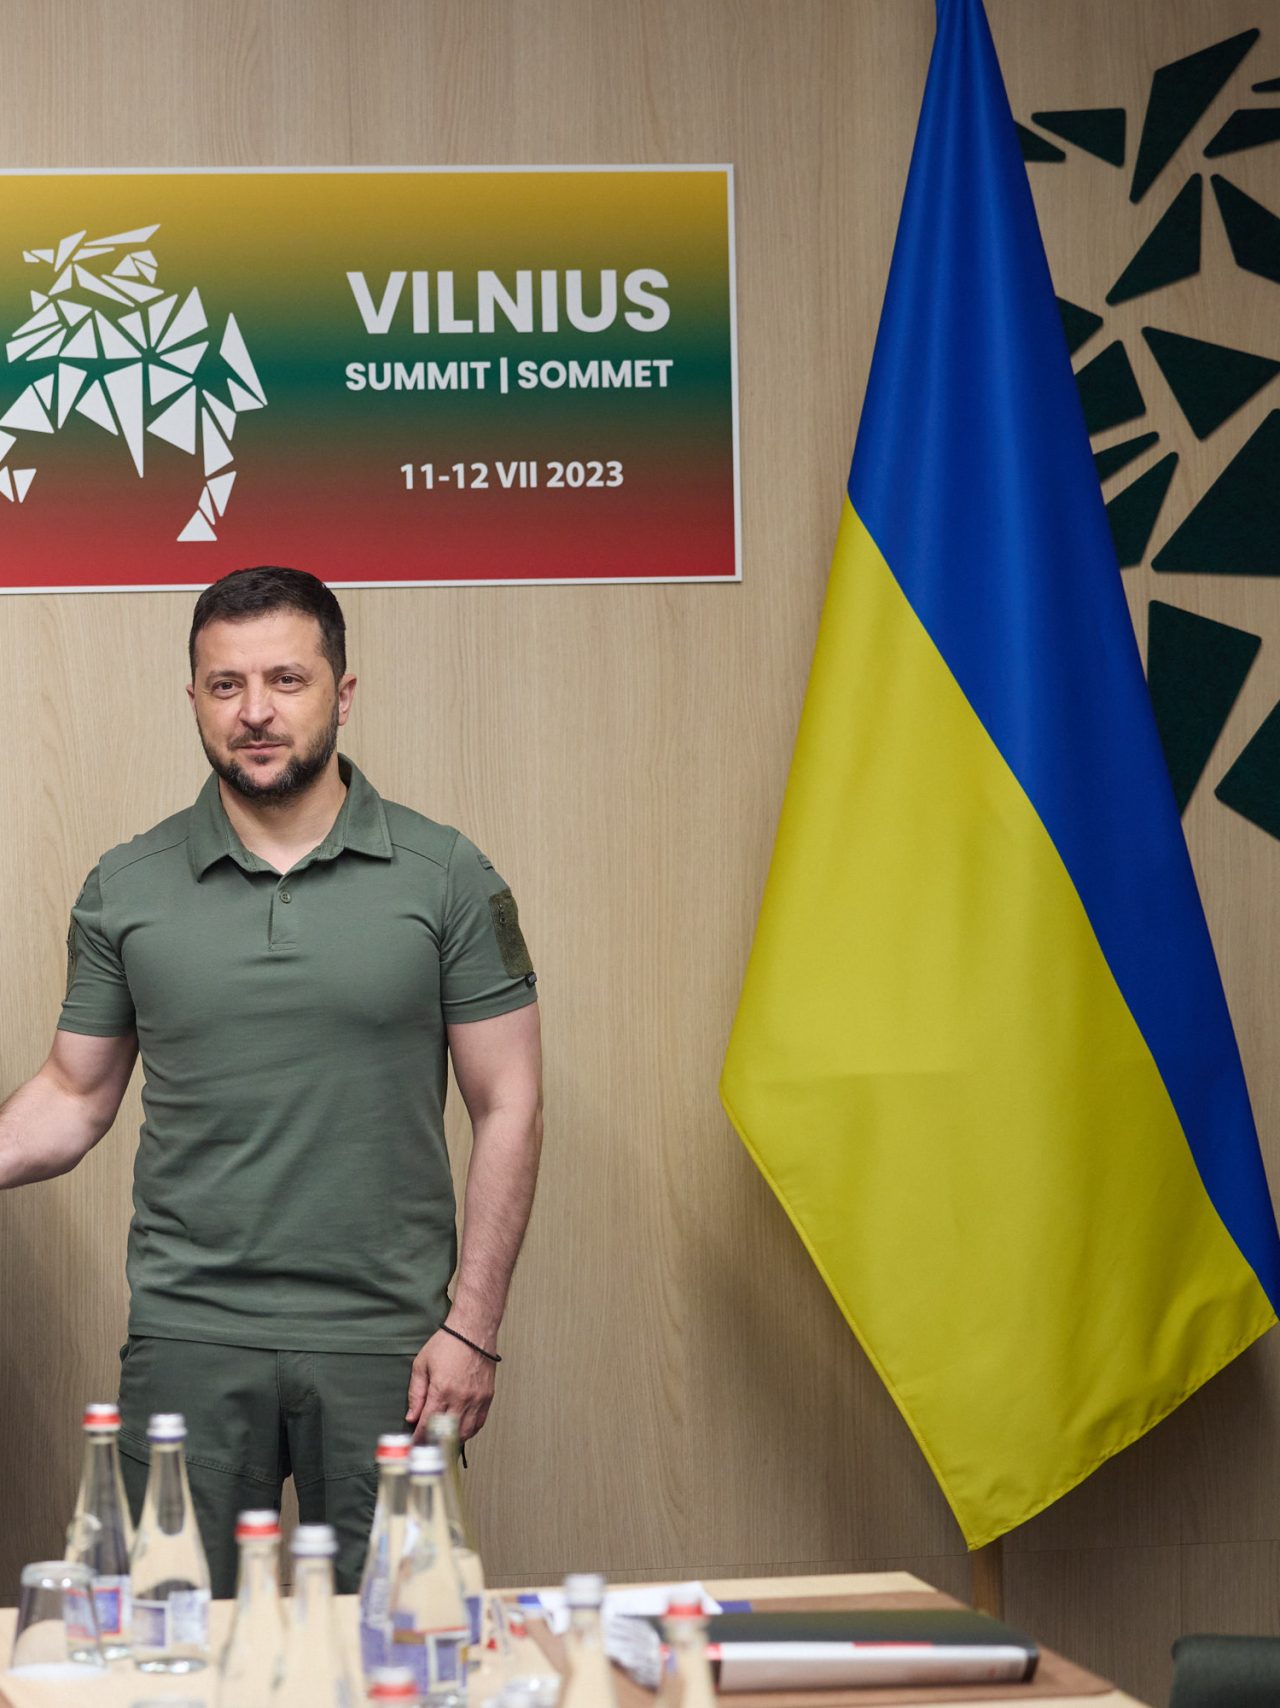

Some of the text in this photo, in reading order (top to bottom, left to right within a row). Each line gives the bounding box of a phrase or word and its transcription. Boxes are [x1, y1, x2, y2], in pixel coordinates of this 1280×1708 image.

[346, 268, 671, 334] VILNIUS
[345, 359, 674, 391] SUMMIT SOMMET
[400, 461, 624, 490] 11-12 VII 2023
